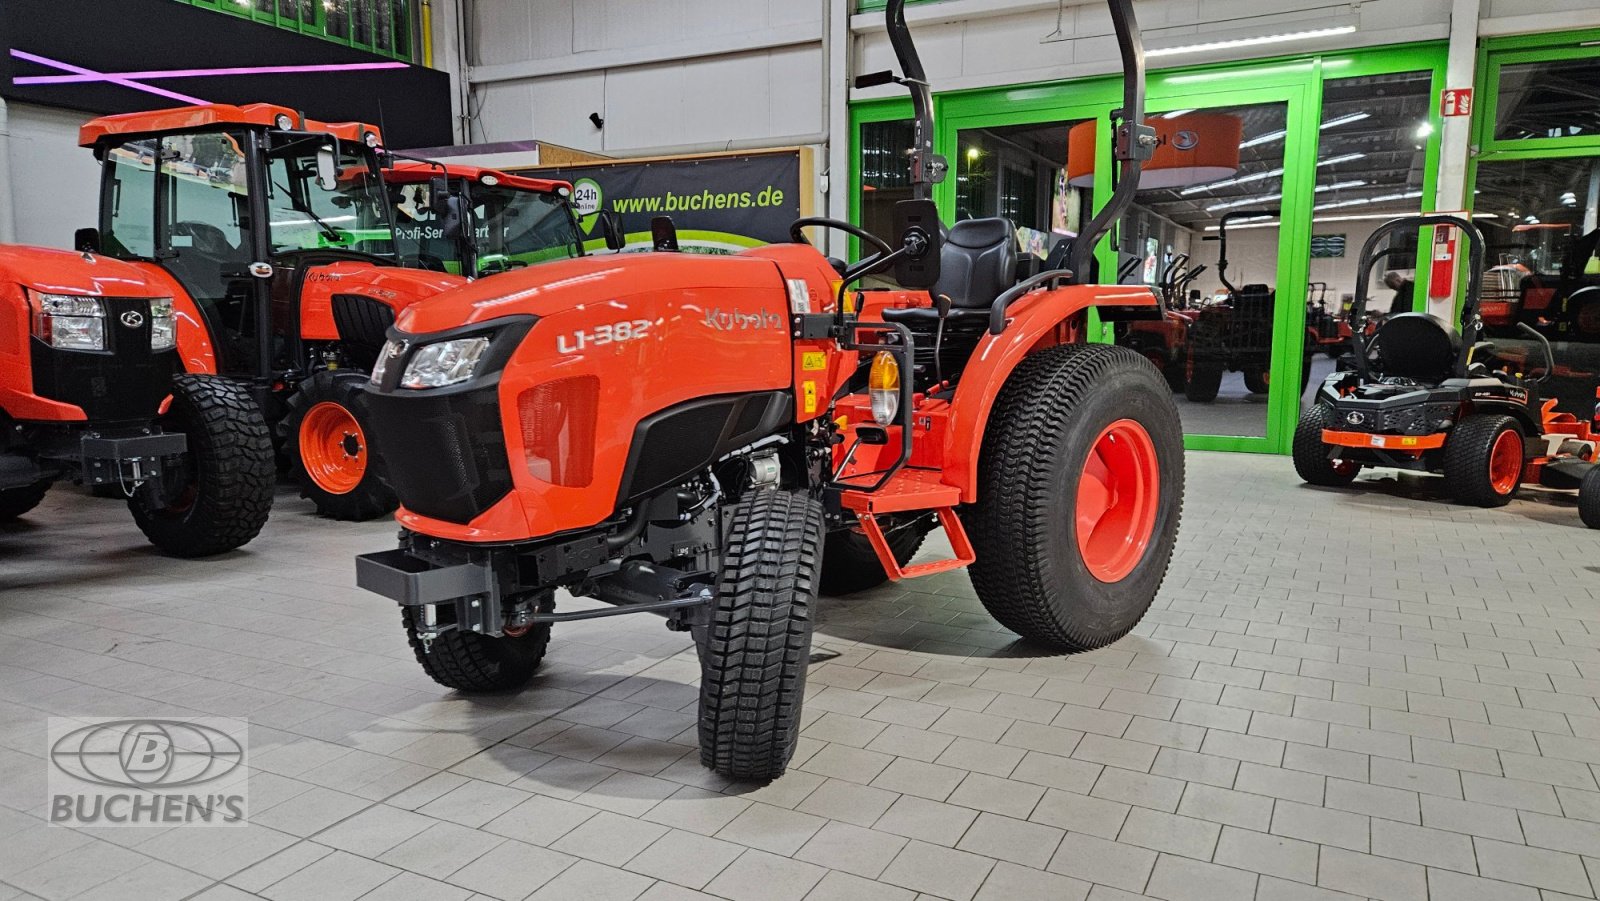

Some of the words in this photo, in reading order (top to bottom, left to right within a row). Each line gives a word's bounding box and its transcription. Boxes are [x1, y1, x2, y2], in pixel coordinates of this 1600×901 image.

[576, 189, 597, 200] 24h
[613, 185, 783, 214] www.buchens.de
[705, 307, 783, 330] Kubota
